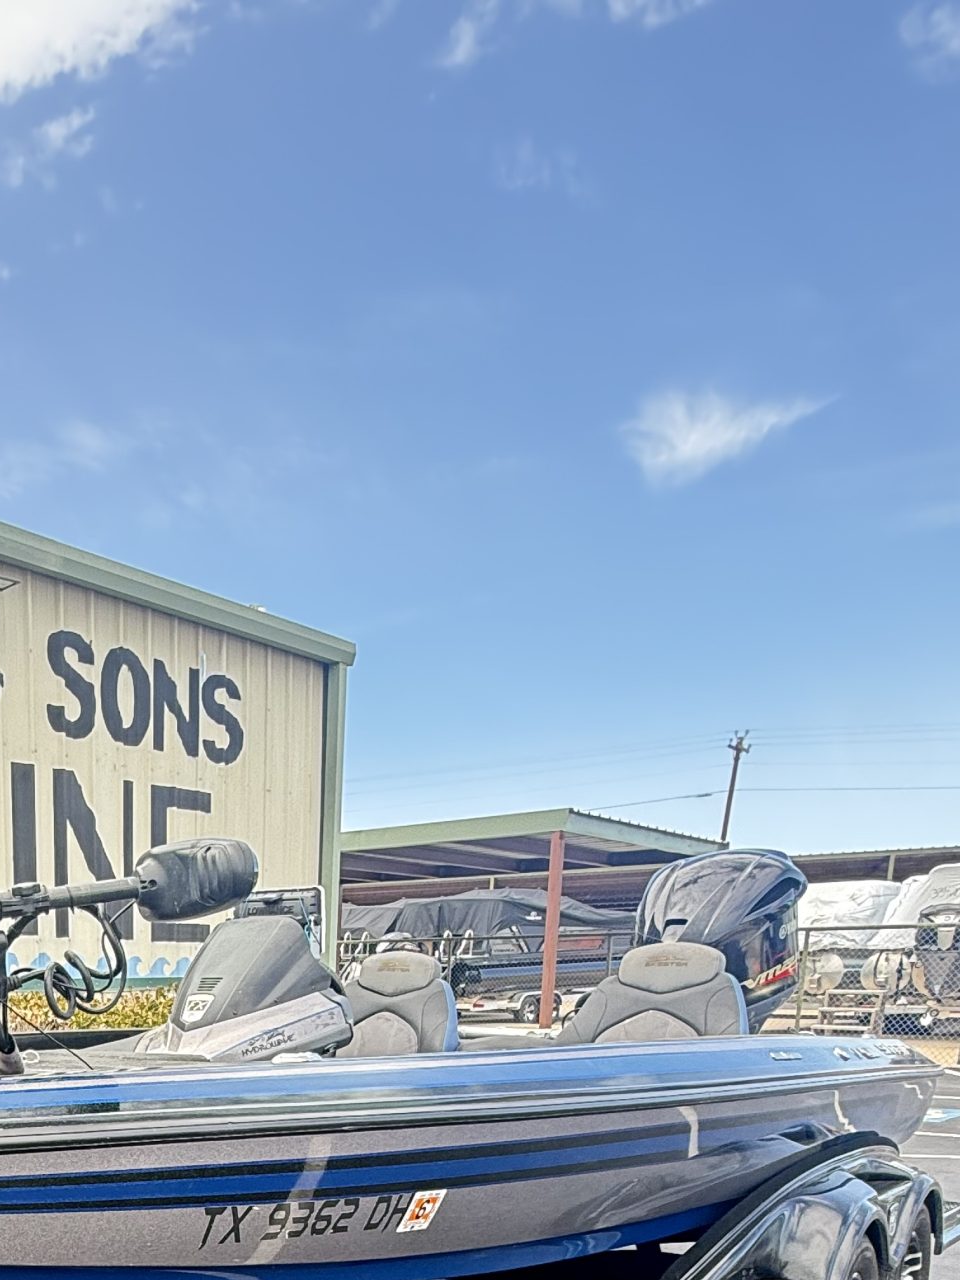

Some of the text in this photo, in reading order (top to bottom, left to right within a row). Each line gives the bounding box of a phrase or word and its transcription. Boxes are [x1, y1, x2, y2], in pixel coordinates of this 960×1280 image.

[46, 629, 244, 766] SONS
[241, 1033, 296, 1057] HYDROWAVE
[198, 1192, 415, 1250] TX 9362 DH
